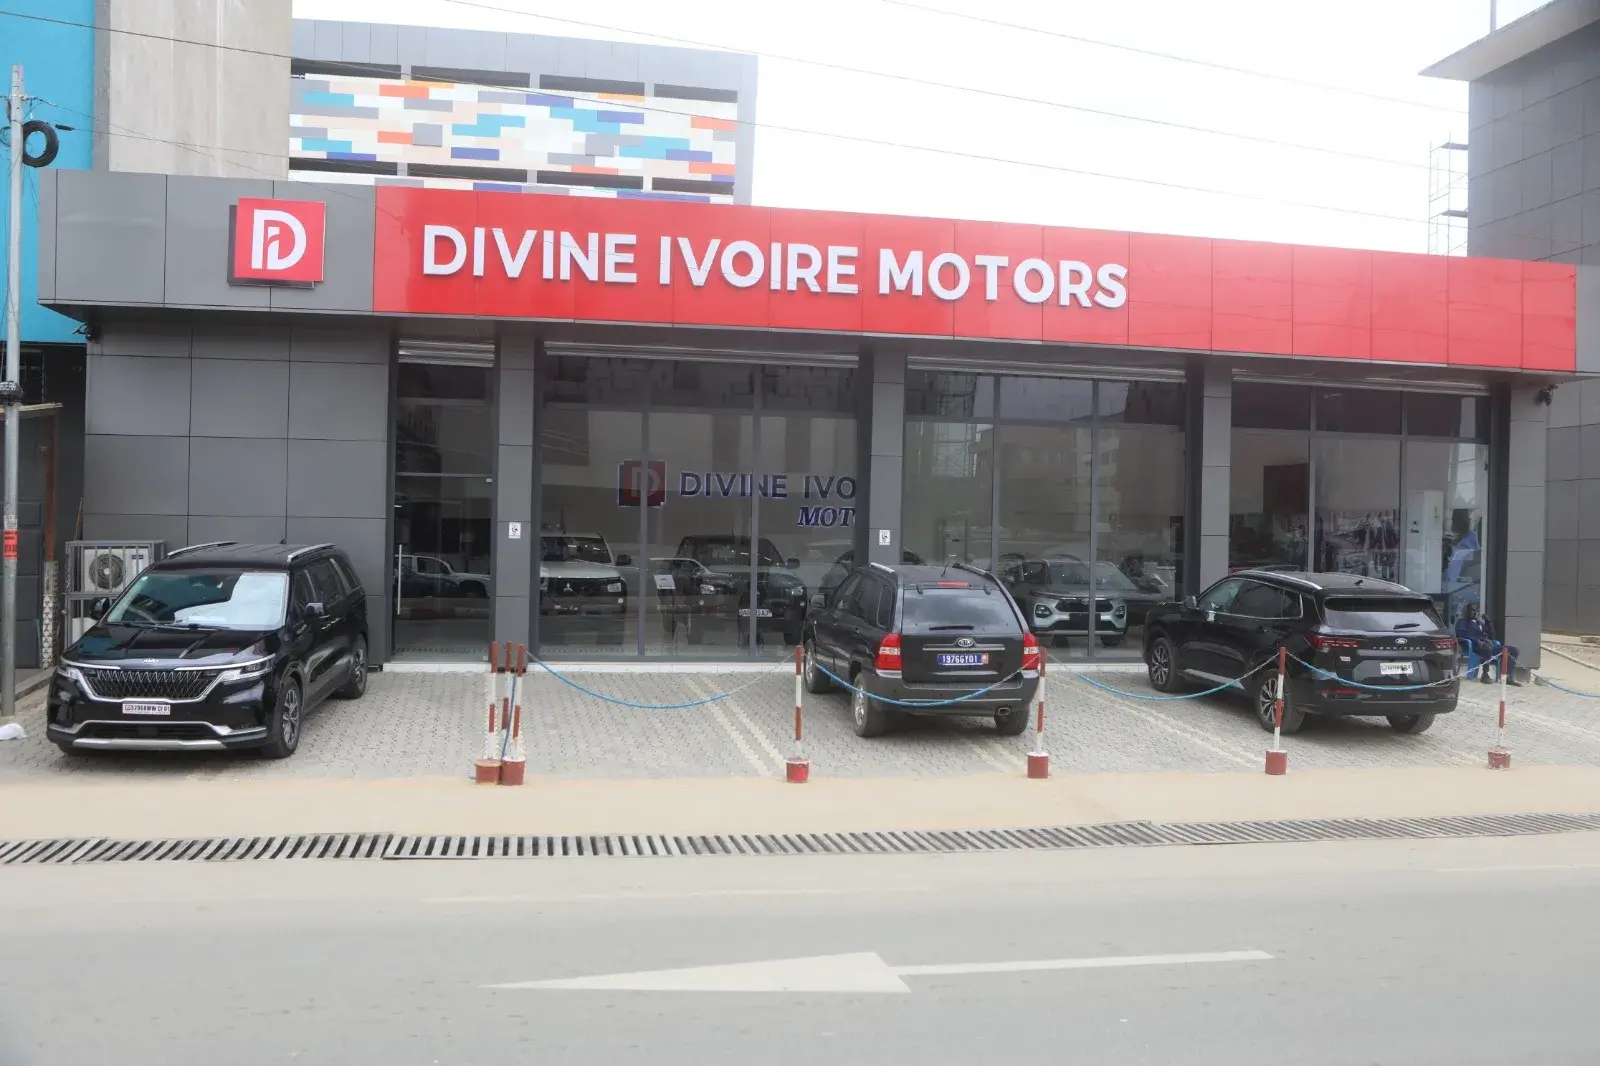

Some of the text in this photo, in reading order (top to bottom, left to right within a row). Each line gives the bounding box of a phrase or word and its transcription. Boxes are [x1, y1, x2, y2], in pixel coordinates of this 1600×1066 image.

[423, 224, 1128, 309] DIVINE IVOIRE MOTORS
[680, 471, 788, 499] DIVINE
